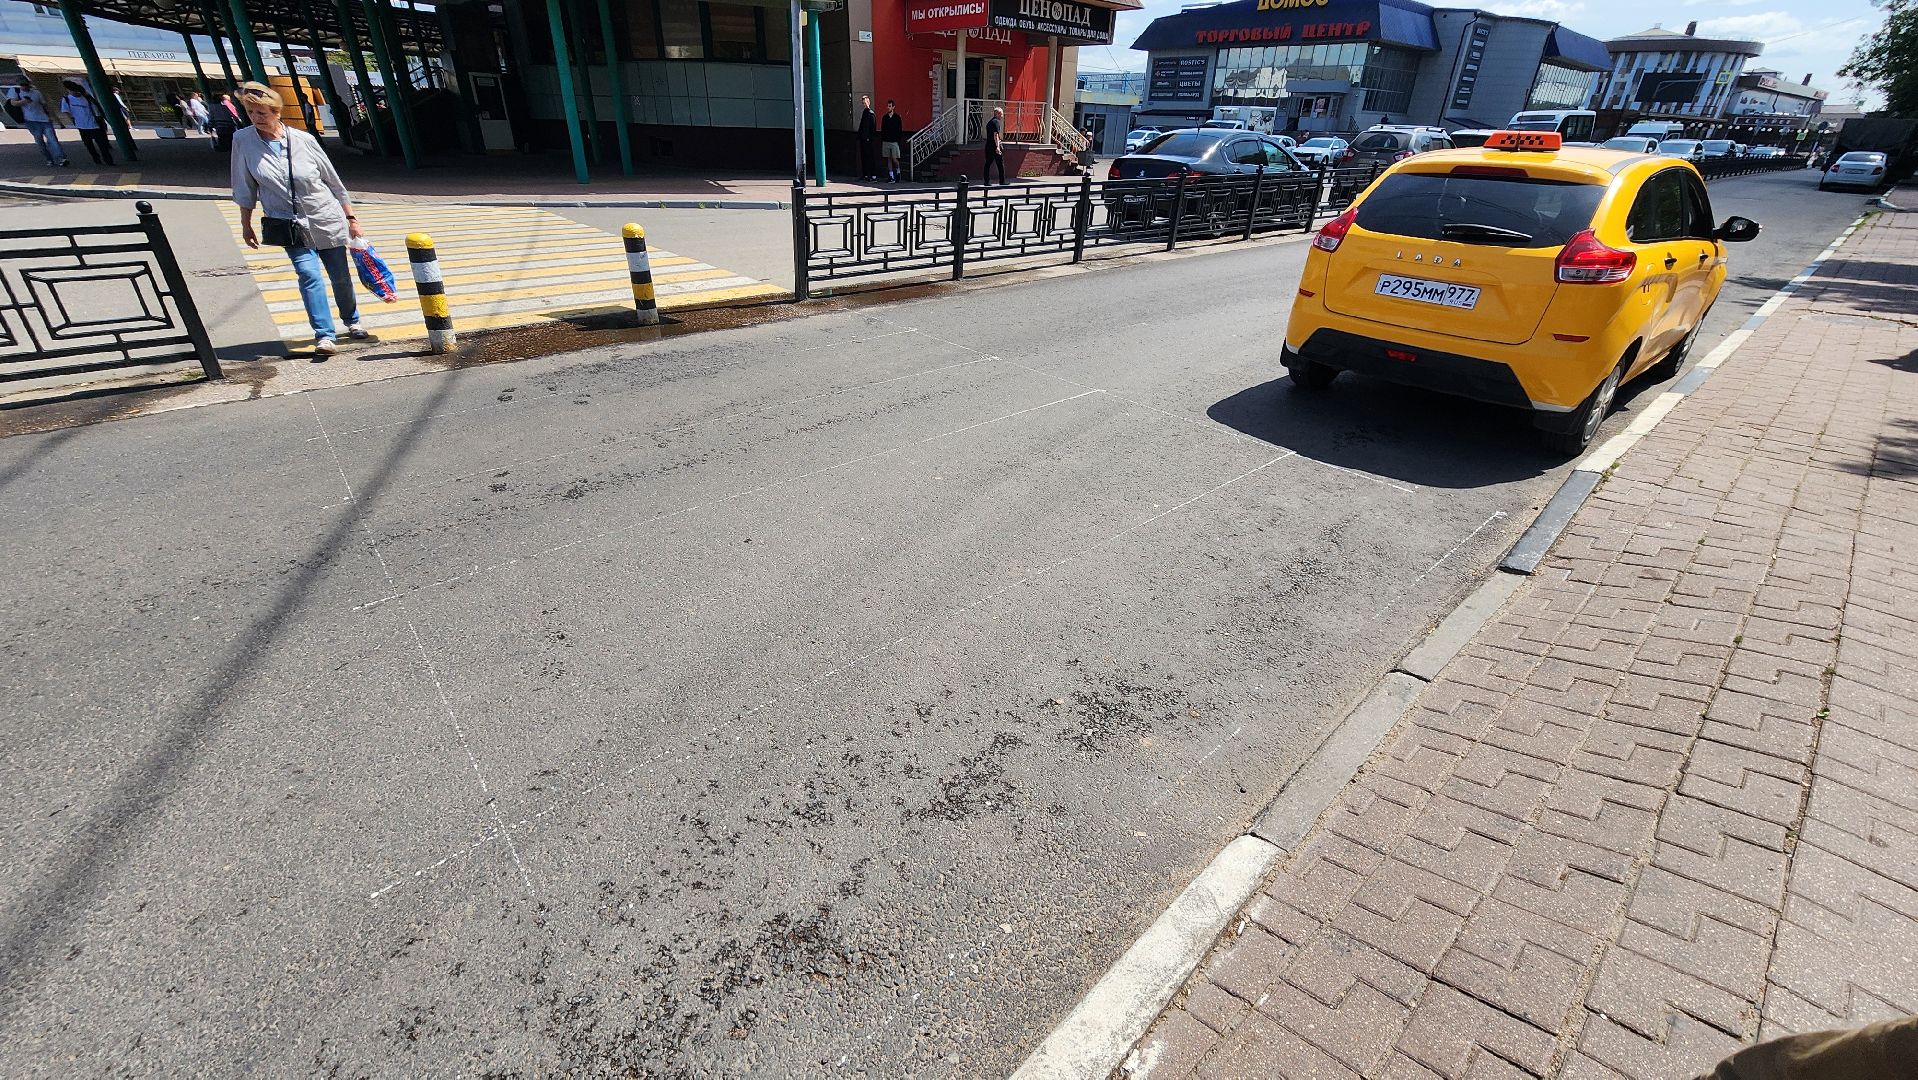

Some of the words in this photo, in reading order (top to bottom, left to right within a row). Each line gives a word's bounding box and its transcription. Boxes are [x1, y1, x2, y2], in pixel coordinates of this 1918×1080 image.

[911, 9, 926, 20] МЫ
[928, 2, 985, 18] ОТКРЫЛИСЬ!
[1019, 0, 1091, 27] ЦЕНОПАД
[994, 15, 1017, 28] ОДЕЖДА
[1019, 19, 1035, 30] ОБУВЬ
[1195, 23, 1293, 43] ТОРГОВЫЙ
[1301, 21, 1372, 39] ЦЕНТР
[127, 50, 177, 60] ПЕКАРНЯ
[1179, 80, 1201, 88] ЦВЕТЫ
[1396, 249, 1462, 268] LADA
[1447, 286, 1476, 302] 977
